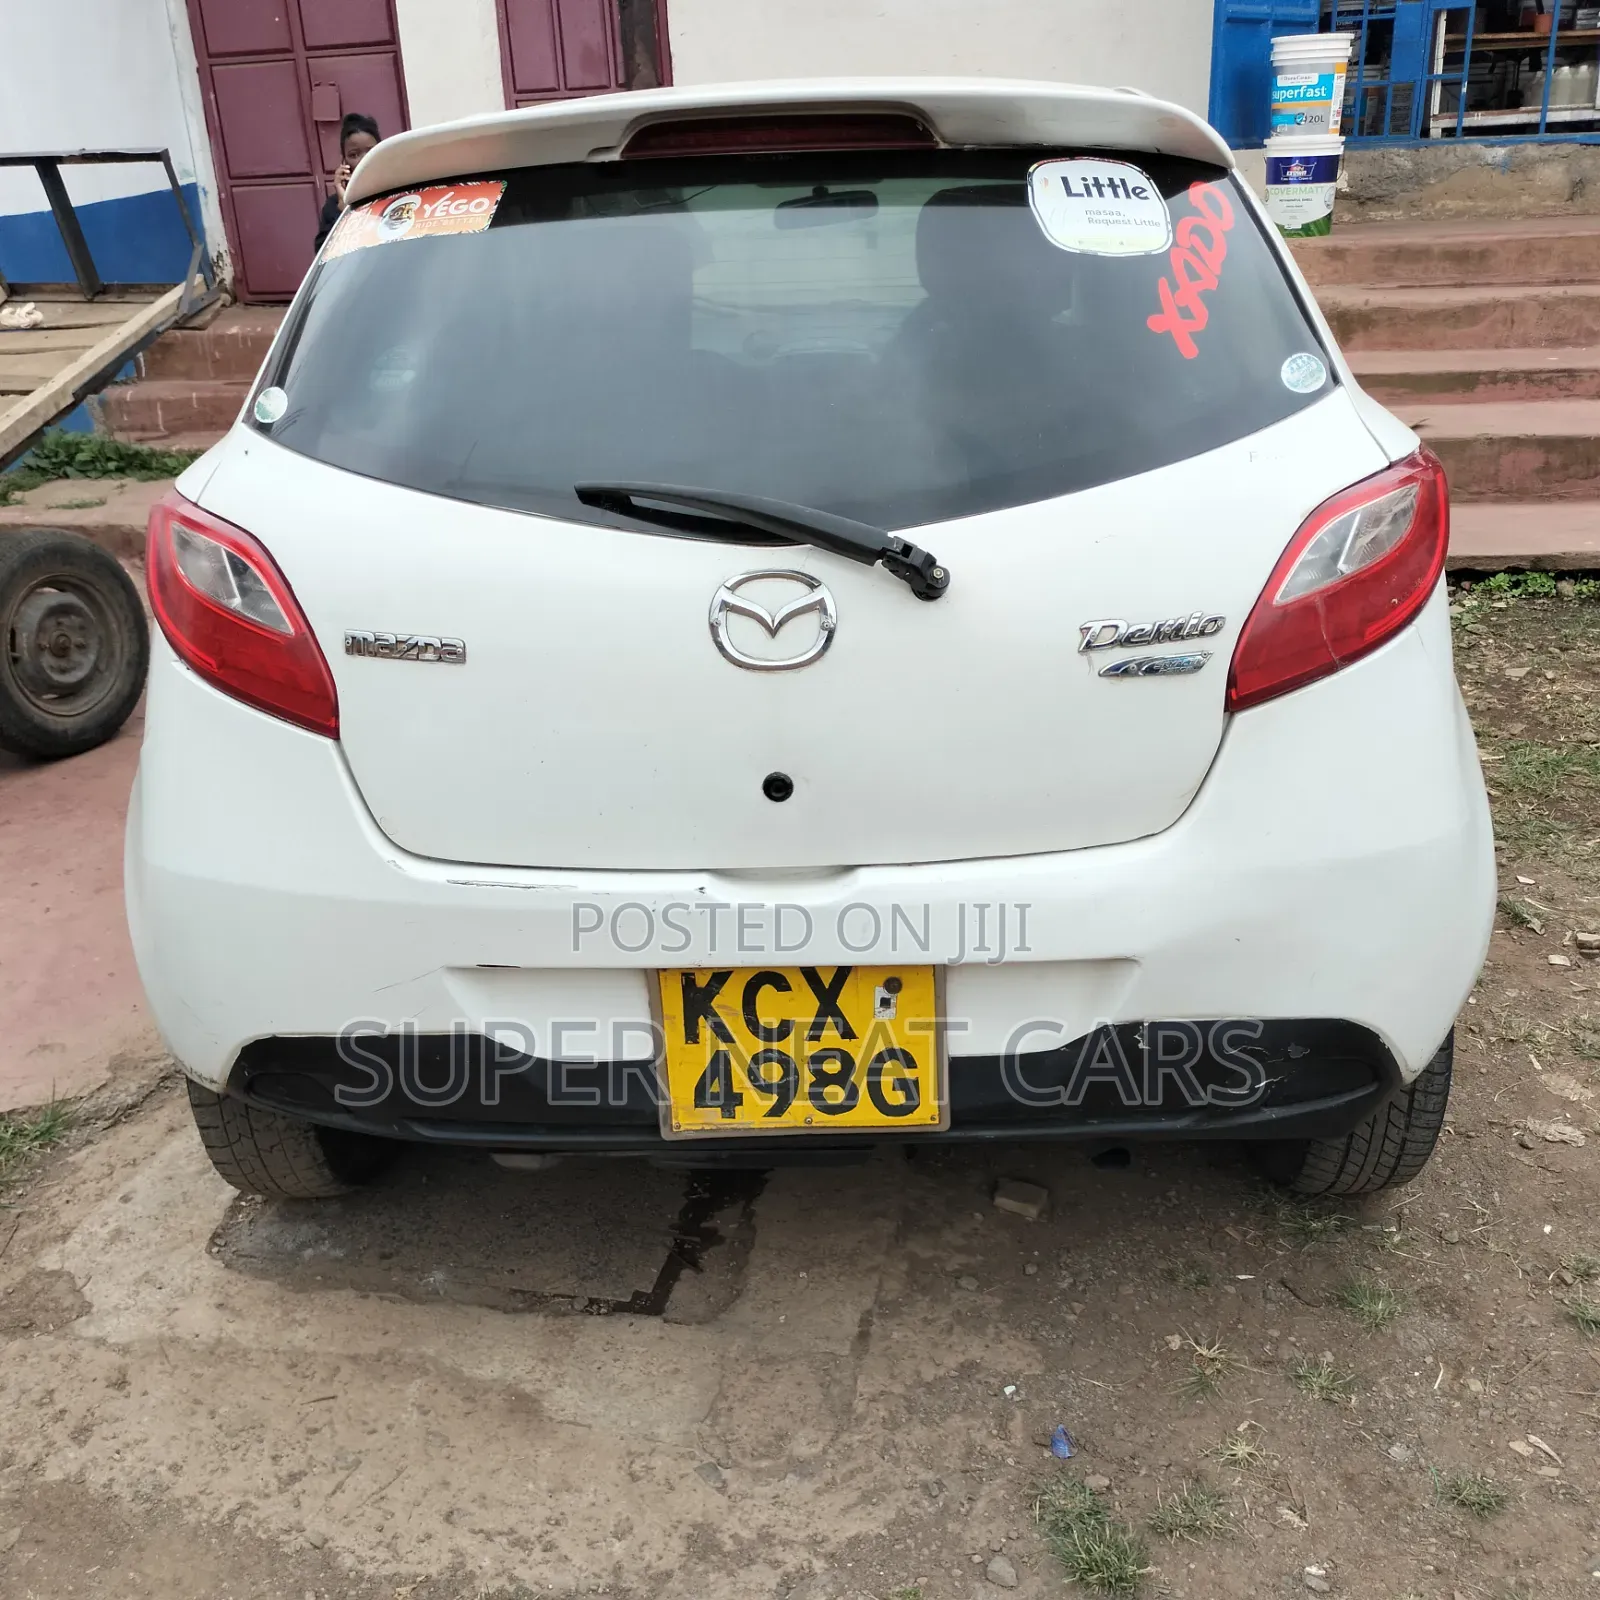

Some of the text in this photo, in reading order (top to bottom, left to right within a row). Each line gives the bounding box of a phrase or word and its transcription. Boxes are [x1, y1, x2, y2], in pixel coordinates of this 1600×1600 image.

[1272, 85, 1327, 102] superfast
[1308, 114, 1325, 124] 20L
[1060, 176, 1150, 200] Little
[1270, 186, 1324, 195] COVERMATT
[423, 191, 490, 218] YEGO
[1088, 217, 1161, 227] Request Little
[1078, 611, 1226, 653] Demio
[344, 629, 466, 665] mazda
[681, 966, 859, 1045] KCX
[693, 1047, 921, 1119] 498G
